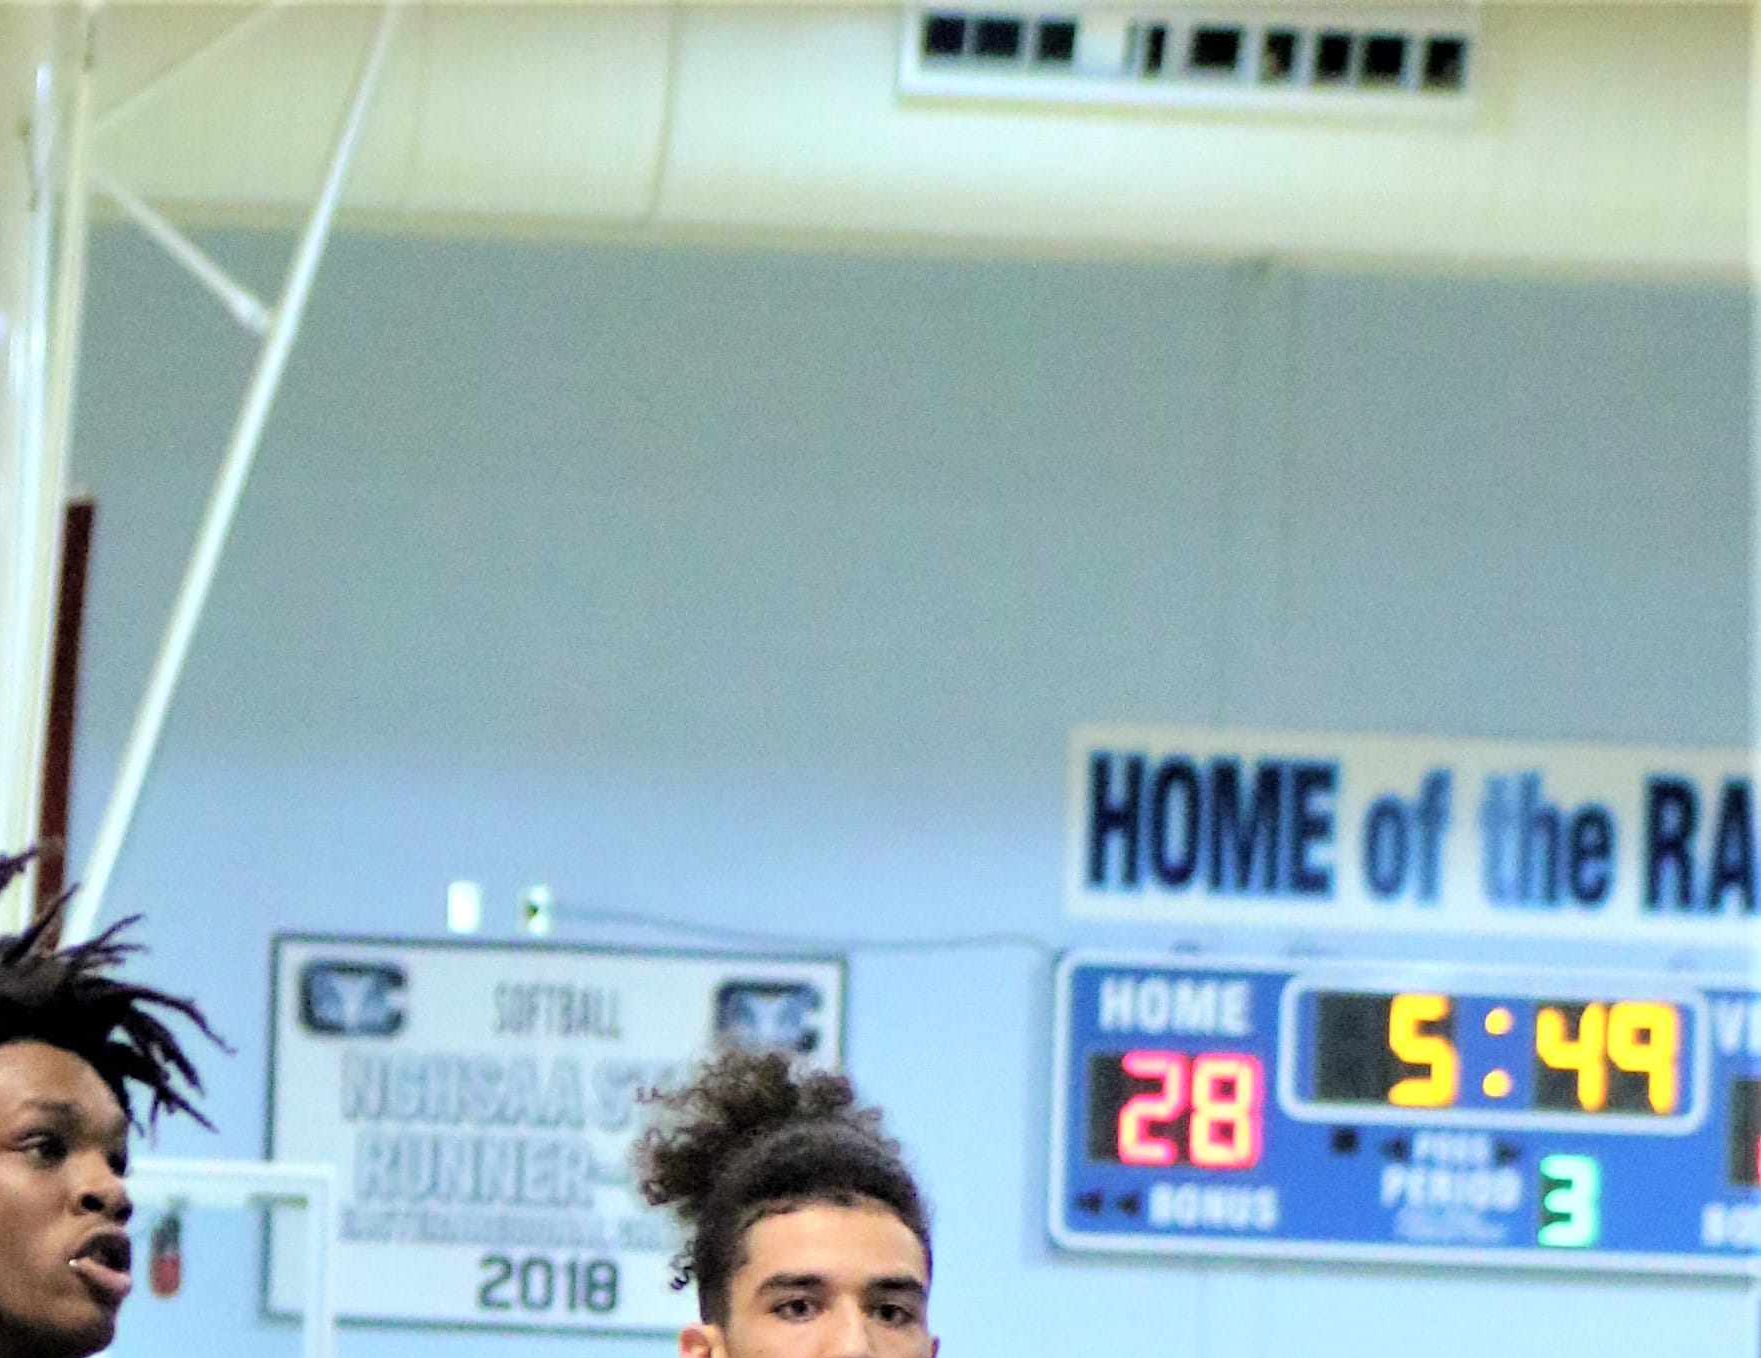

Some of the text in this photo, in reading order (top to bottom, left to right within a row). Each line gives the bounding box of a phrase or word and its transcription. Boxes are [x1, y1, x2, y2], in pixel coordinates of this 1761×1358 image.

[1084, 751, 1341, 896] HOME
[1360, 768, 1452, 903] of
[1479, 769, 1617, 910] the
[493, 980, 622, 1040] SOFTBALL
[1097, 976, 1253, 1036] HOME
[1388, 992, 1682, 1115] 5:49
[1117, 1049, 1264, 1170] 28
[1149, 1181, 1281, 1232] BONUS
[1537, 1153, 1602, 1249] 3
[478, 1254, 621, 1314] 2018
